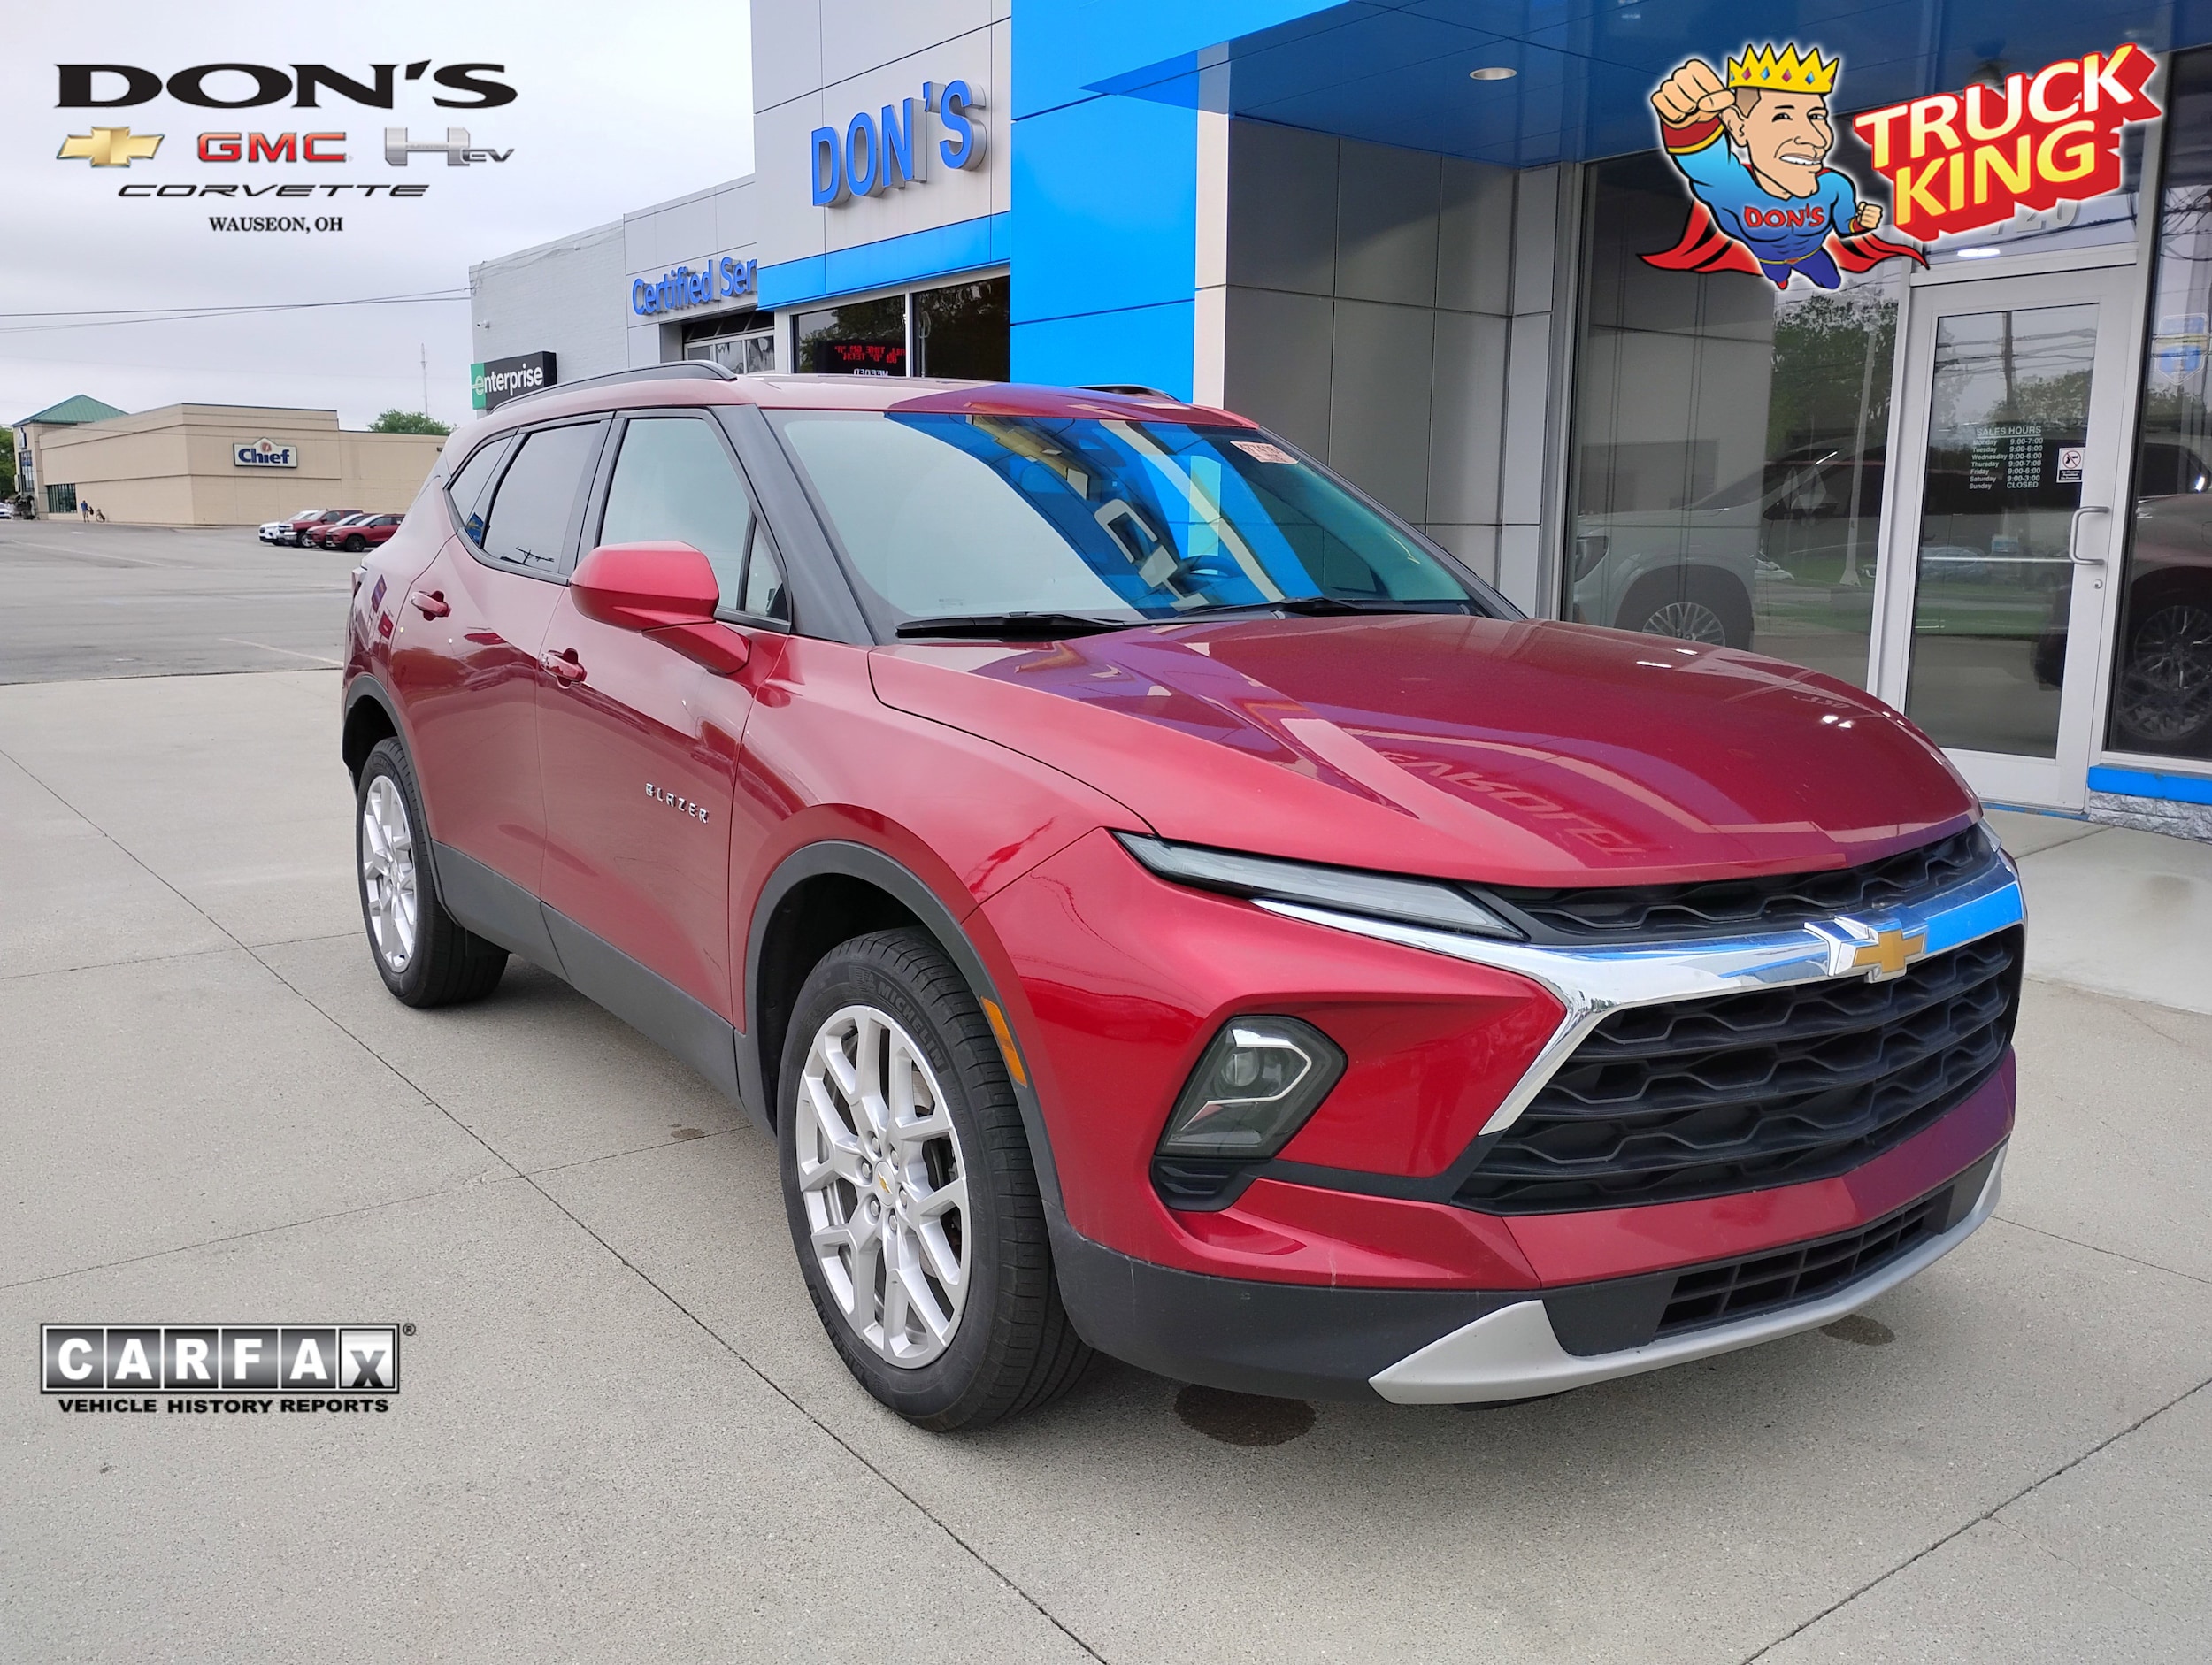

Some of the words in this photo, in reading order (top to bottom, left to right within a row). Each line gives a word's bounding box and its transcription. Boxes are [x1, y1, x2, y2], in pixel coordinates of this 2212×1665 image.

[811, 79, 982, 207] DON'S
[633, 259, 714, 316] Certified
[472, 363, 543, 396] enterprise
[1977, 426, 2006, 436] SALES
[2008, 426, 2042, 434] HOURS
[238, 448, 290, 464] Chief
[645, 782, 710, 824] BLAZER
[876, 981, 944, 1070] MICHELIN
